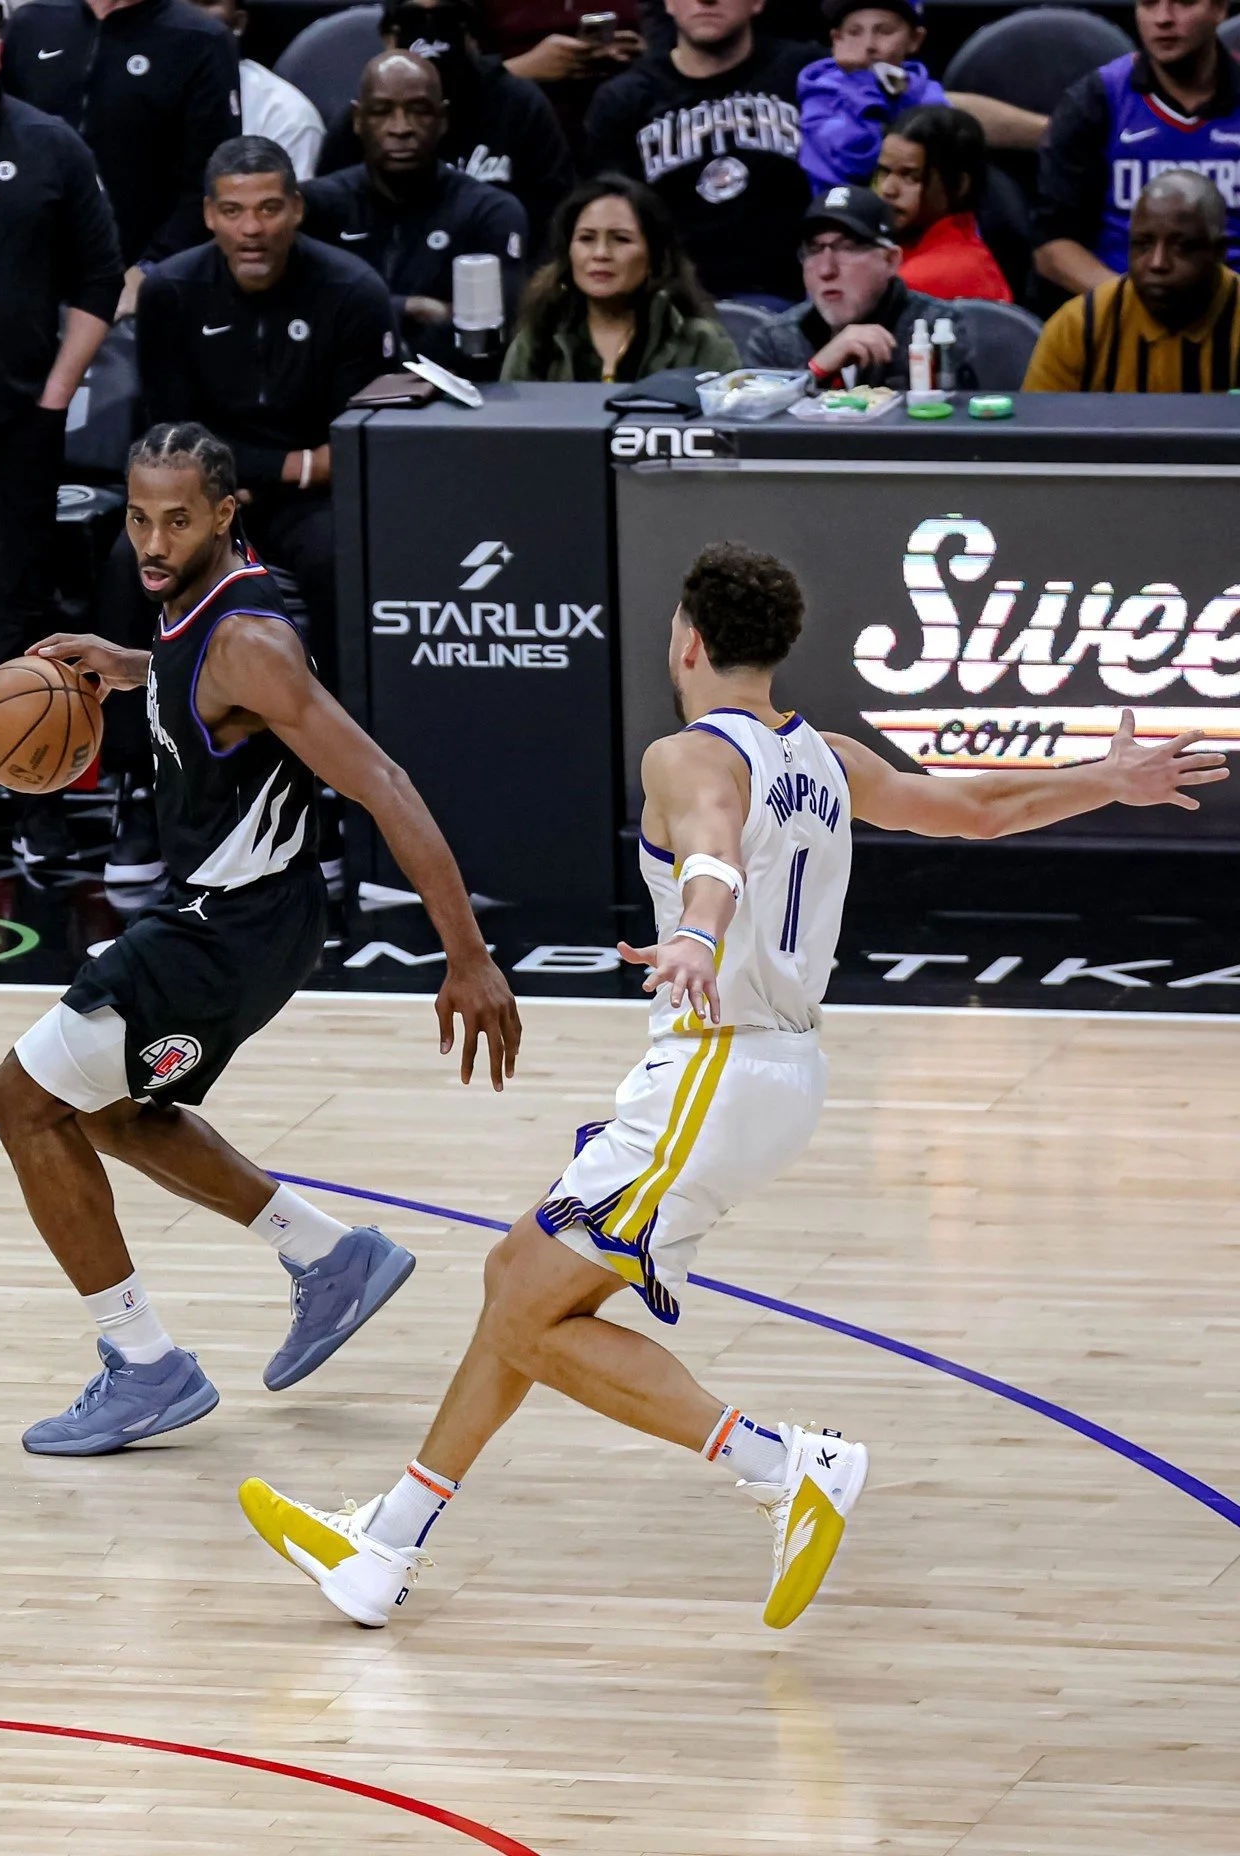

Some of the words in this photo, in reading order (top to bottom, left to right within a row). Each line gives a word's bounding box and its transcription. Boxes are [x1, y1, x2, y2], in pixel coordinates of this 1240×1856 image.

[636, 92, 803, 183] CLIPPERS
[611, 427, 715, 457] anc
[372, 601, 605, 639] STARLUX
[411, 642, 569, 668] AIRLINES
[766, 772, 840, 834] THOMPSON
